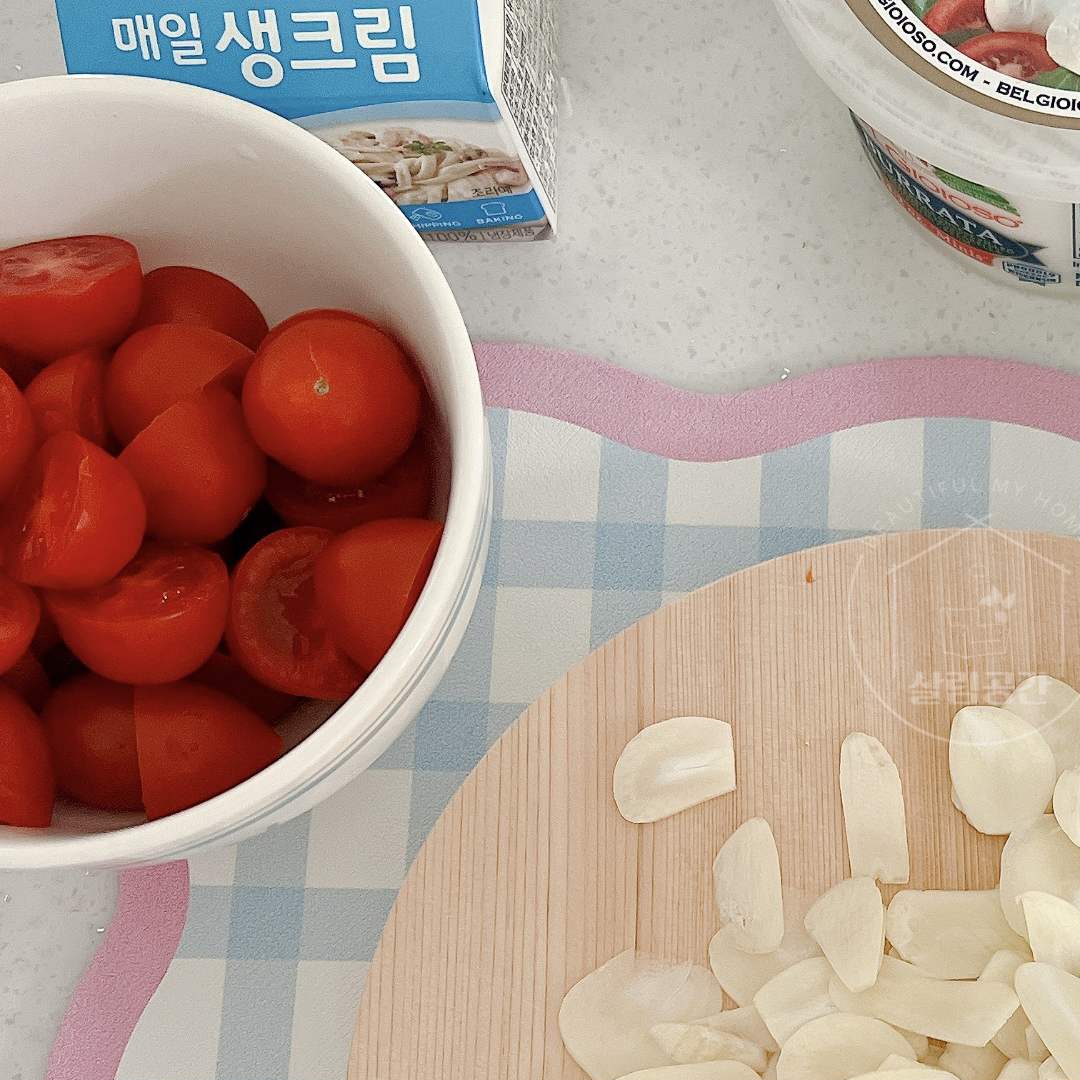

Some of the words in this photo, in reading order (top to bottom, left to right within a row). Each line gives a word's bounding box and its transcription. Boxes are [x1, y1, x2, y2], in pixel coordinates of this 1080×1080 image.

[111, 12, 207, 65] 매일
[215, 5, 421, 88] 생크림
[471, 186, 512, 198] 조리예
[476, 213, 524, 225] BAKING
[427, 230, 477, 242] 100%
